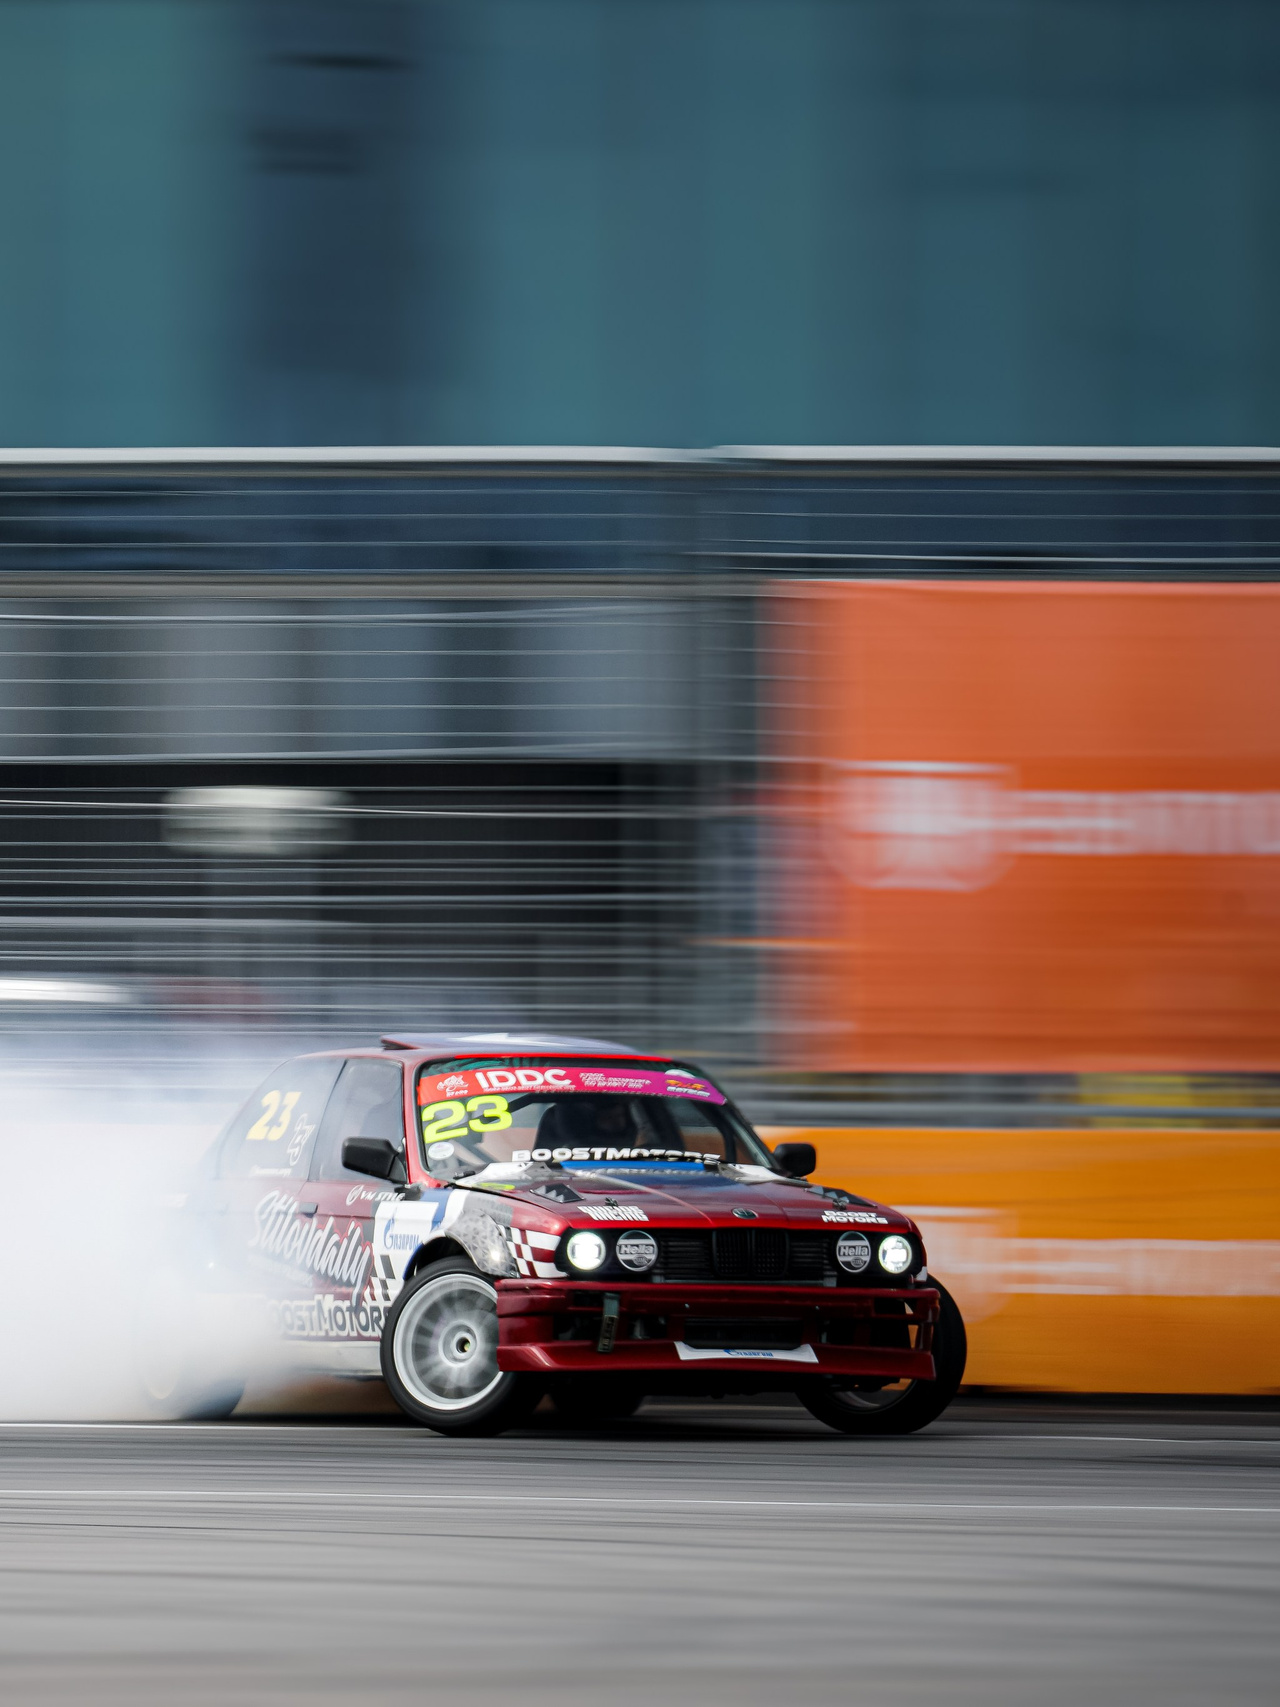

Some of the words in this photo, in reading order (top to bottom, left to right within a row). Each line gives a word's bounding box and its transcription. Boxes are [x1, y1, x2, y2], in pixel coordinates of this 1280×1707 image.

[475, 1069, 572, 1090] IDDC
[246, 1090, 302, 1141] 23
[422, 1095, 513, 1144] 23
[821, 1215, 889, 1225] MOTORS
[823, 1210, 878, 1218] BOOST
[619, 1243, 655, 1255] Hella
[839, 1245, 869, 1257] Hella
